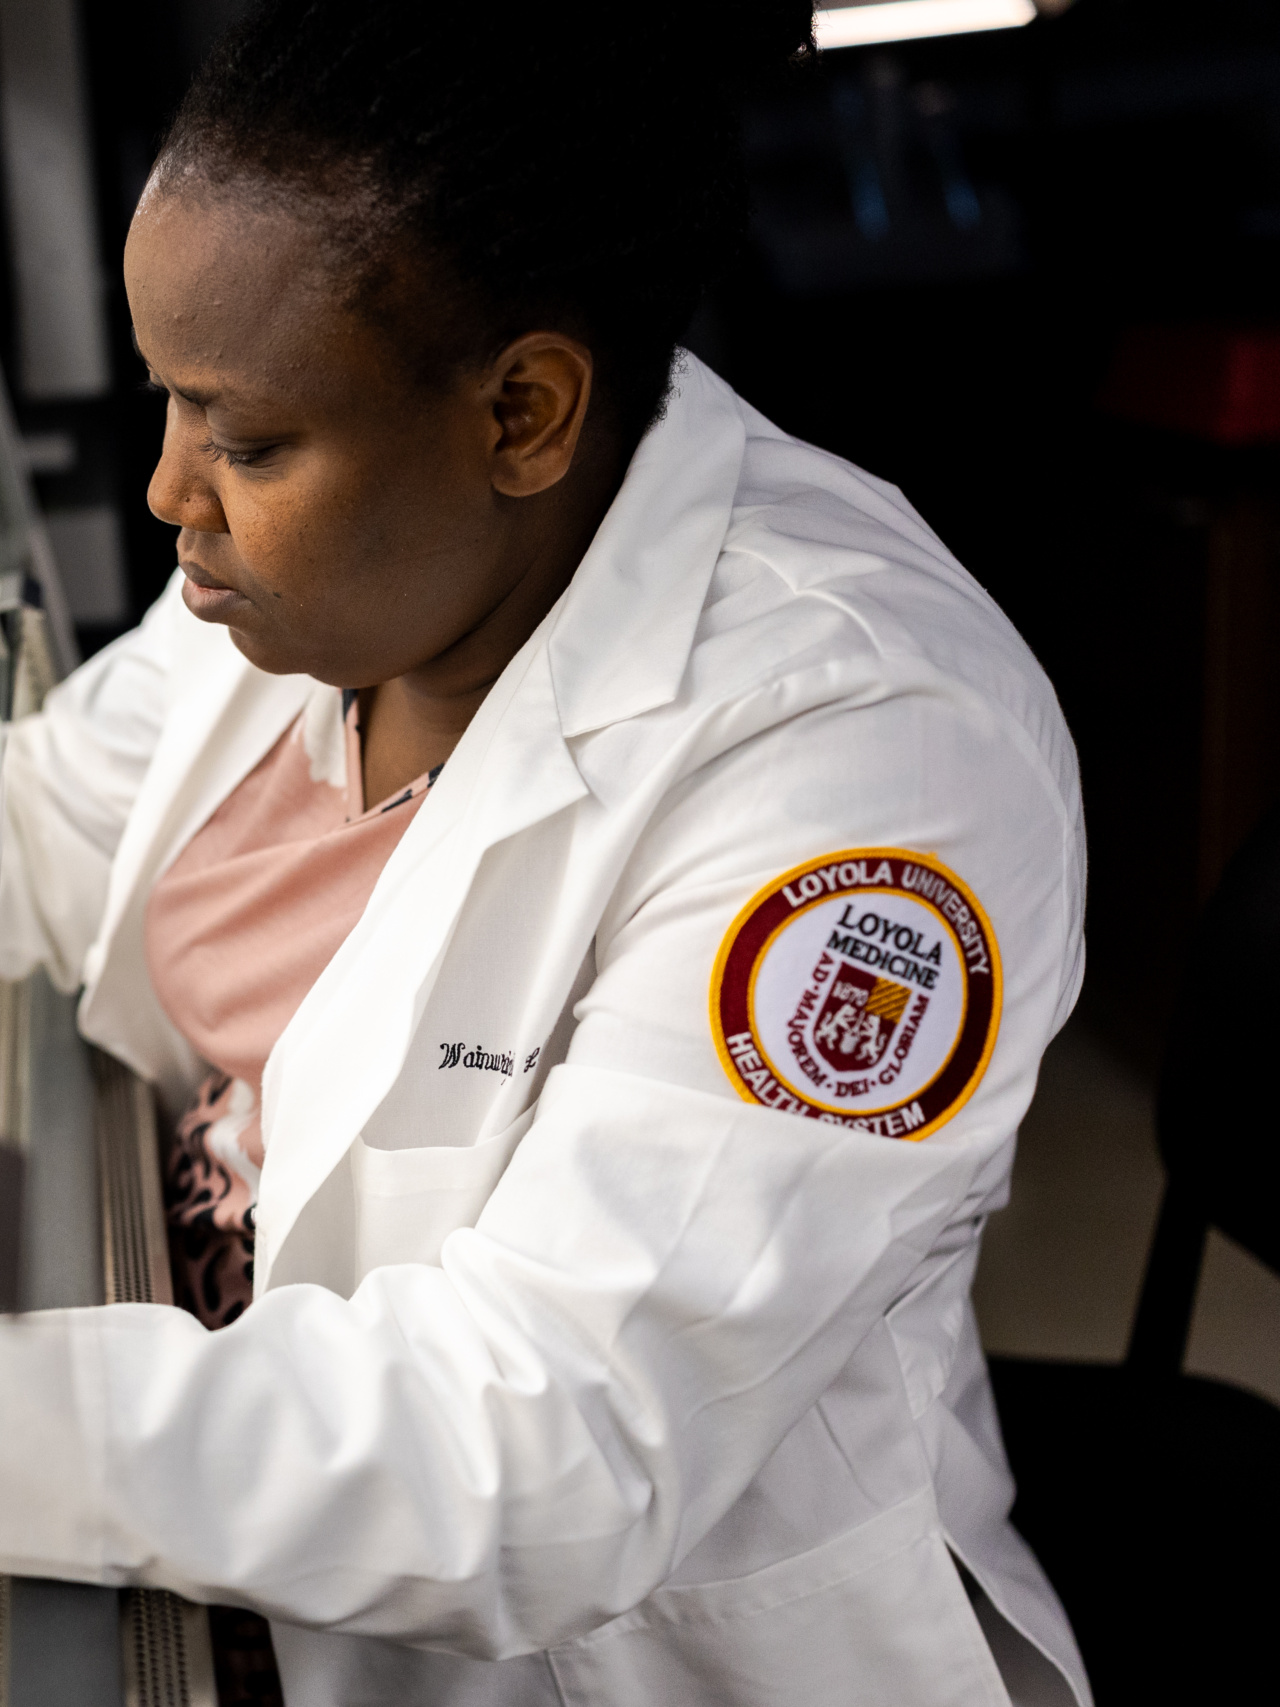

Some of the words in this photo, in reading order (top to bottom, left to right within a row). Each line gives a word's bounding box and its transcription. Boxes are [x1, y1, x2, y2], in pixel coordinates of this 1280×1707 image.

[781, 860, 894, 907] LOYOLA
[901, 863, 990, 977] UNIVERSITY
[837, 903, 942, 966] LOYOLA
[813, 951, 834, 983] AD
[826, 930, 941, 990] MEDICINE
[787, 989, 828, 1087] MAJOREM
[878, 993, 930, 1085] GLORIAM
[834, 1078, 870, 1097] DEI
